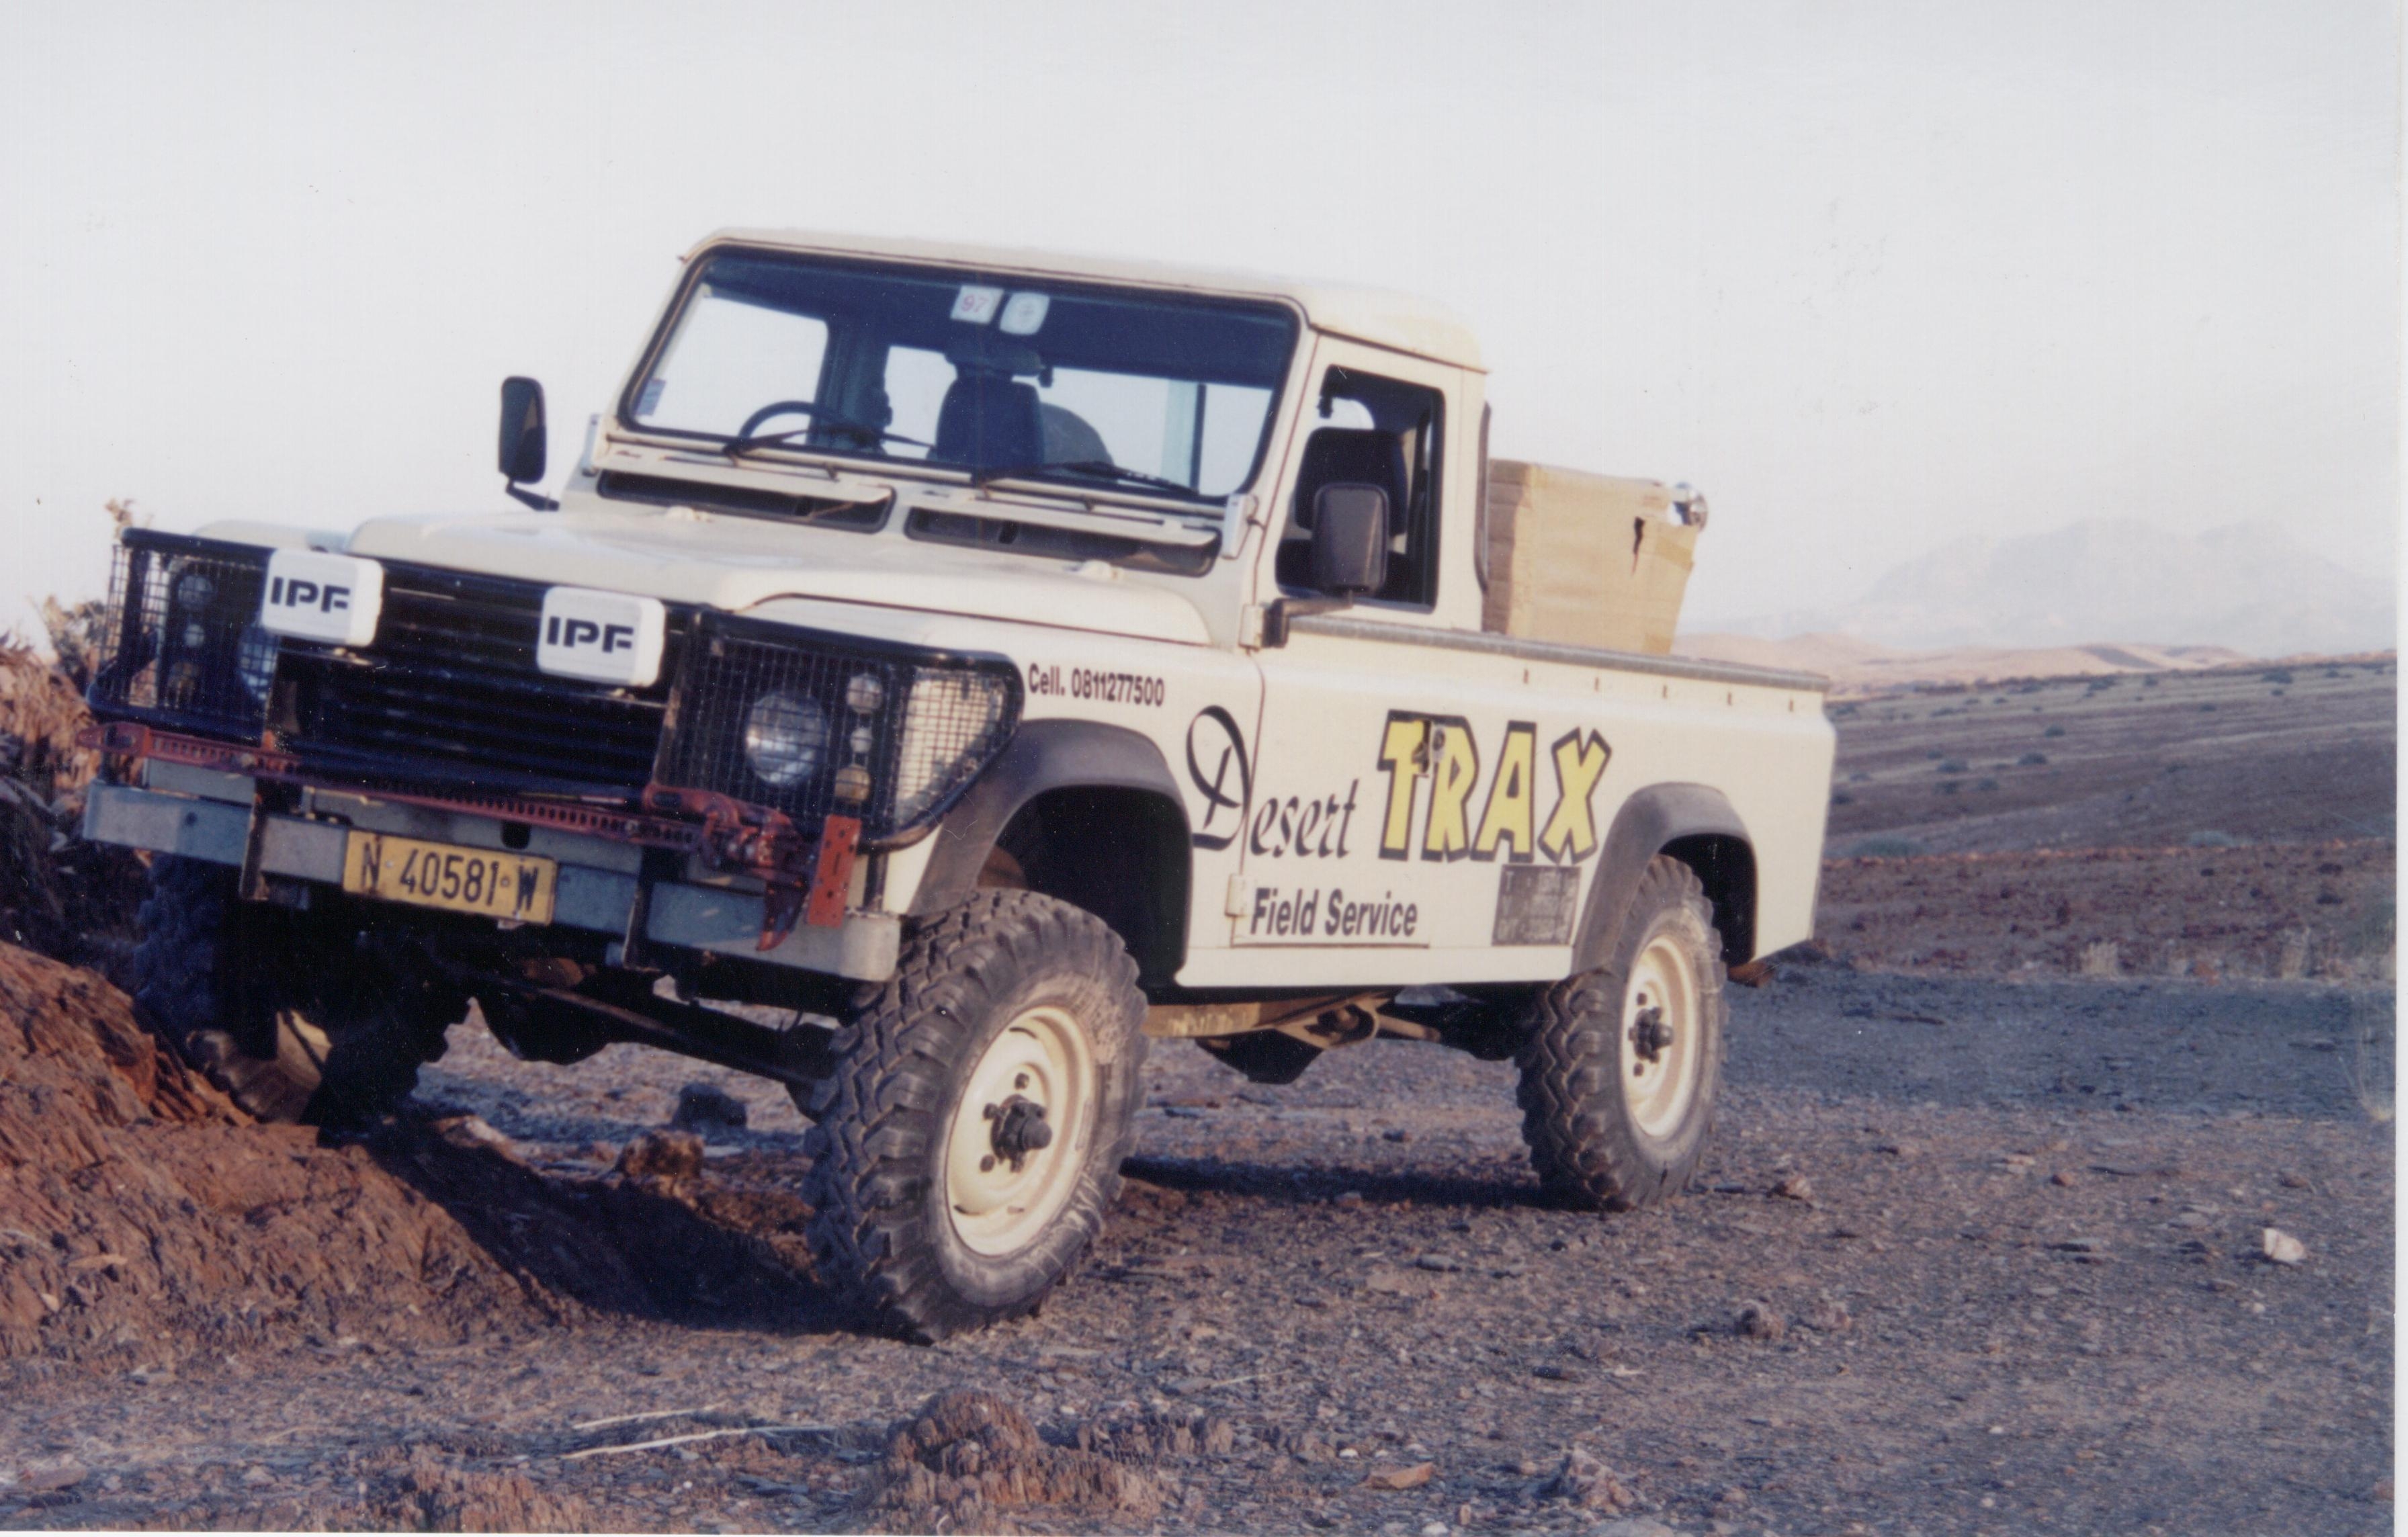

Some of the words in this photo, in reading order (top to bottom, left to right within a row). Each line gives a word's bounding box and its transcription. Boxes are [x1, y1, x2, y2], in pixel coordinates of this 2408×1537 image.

[961, 294, 990, 313] 97
[269, 576, 351, 613] IPF
[546, 616, 635, 653] IPF
[1028, 662, 1066, 696] Cell.
[1071, 668, 1165, 707] 0811277500
[1186, 705, 1360, 859] Desert
[1377, 709, 1612, 865] TRAX
[360, 842, 383, 891] N
[399, 848, 501, 908] 40581
[514, 864, 539, 912] W
[1249, 887, 1320, 936] Field
[1324, 891, 1418, 937] Service
